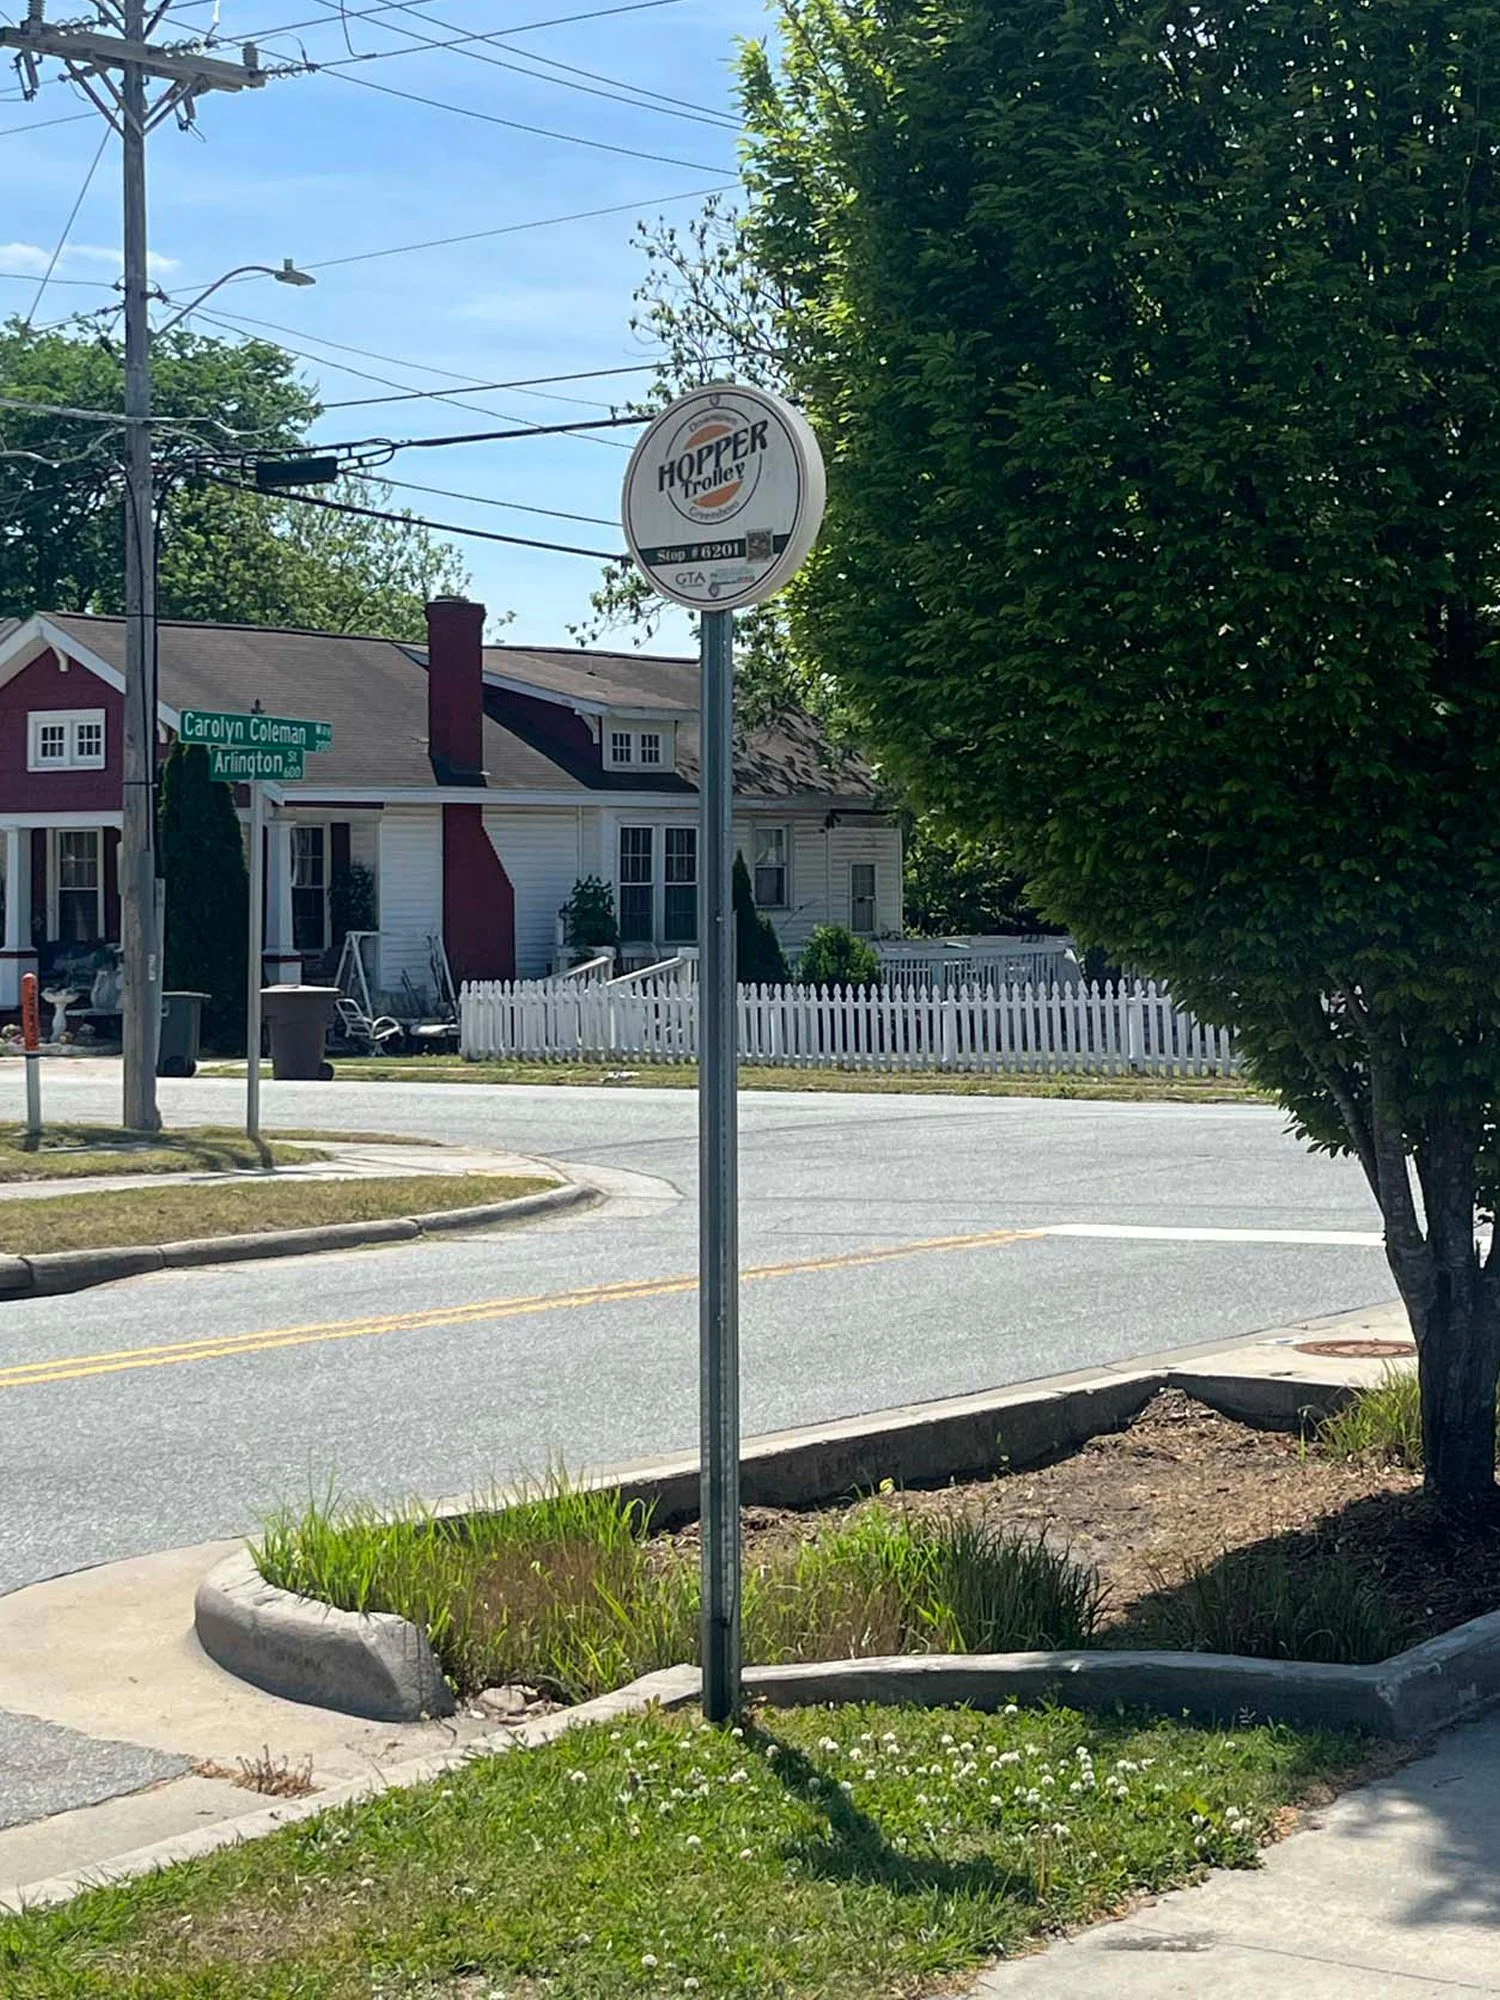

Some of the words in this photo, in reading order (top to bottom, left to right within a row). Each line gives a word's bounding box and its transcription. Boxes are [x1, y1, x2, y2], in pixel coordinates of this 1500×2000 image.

[658, 420, 768, 492] HOPPER
[681, 461, 746, 499] Trolley
[657, 549, 686, 562] Stop
[675, 571, 706, 585] GTA
[184, 712, 244, 745] Carolyn
[249, 718, 307, 746] Coleman
[214, 751, 283, 780] Arlington
[287, 750, 298, 763] St
